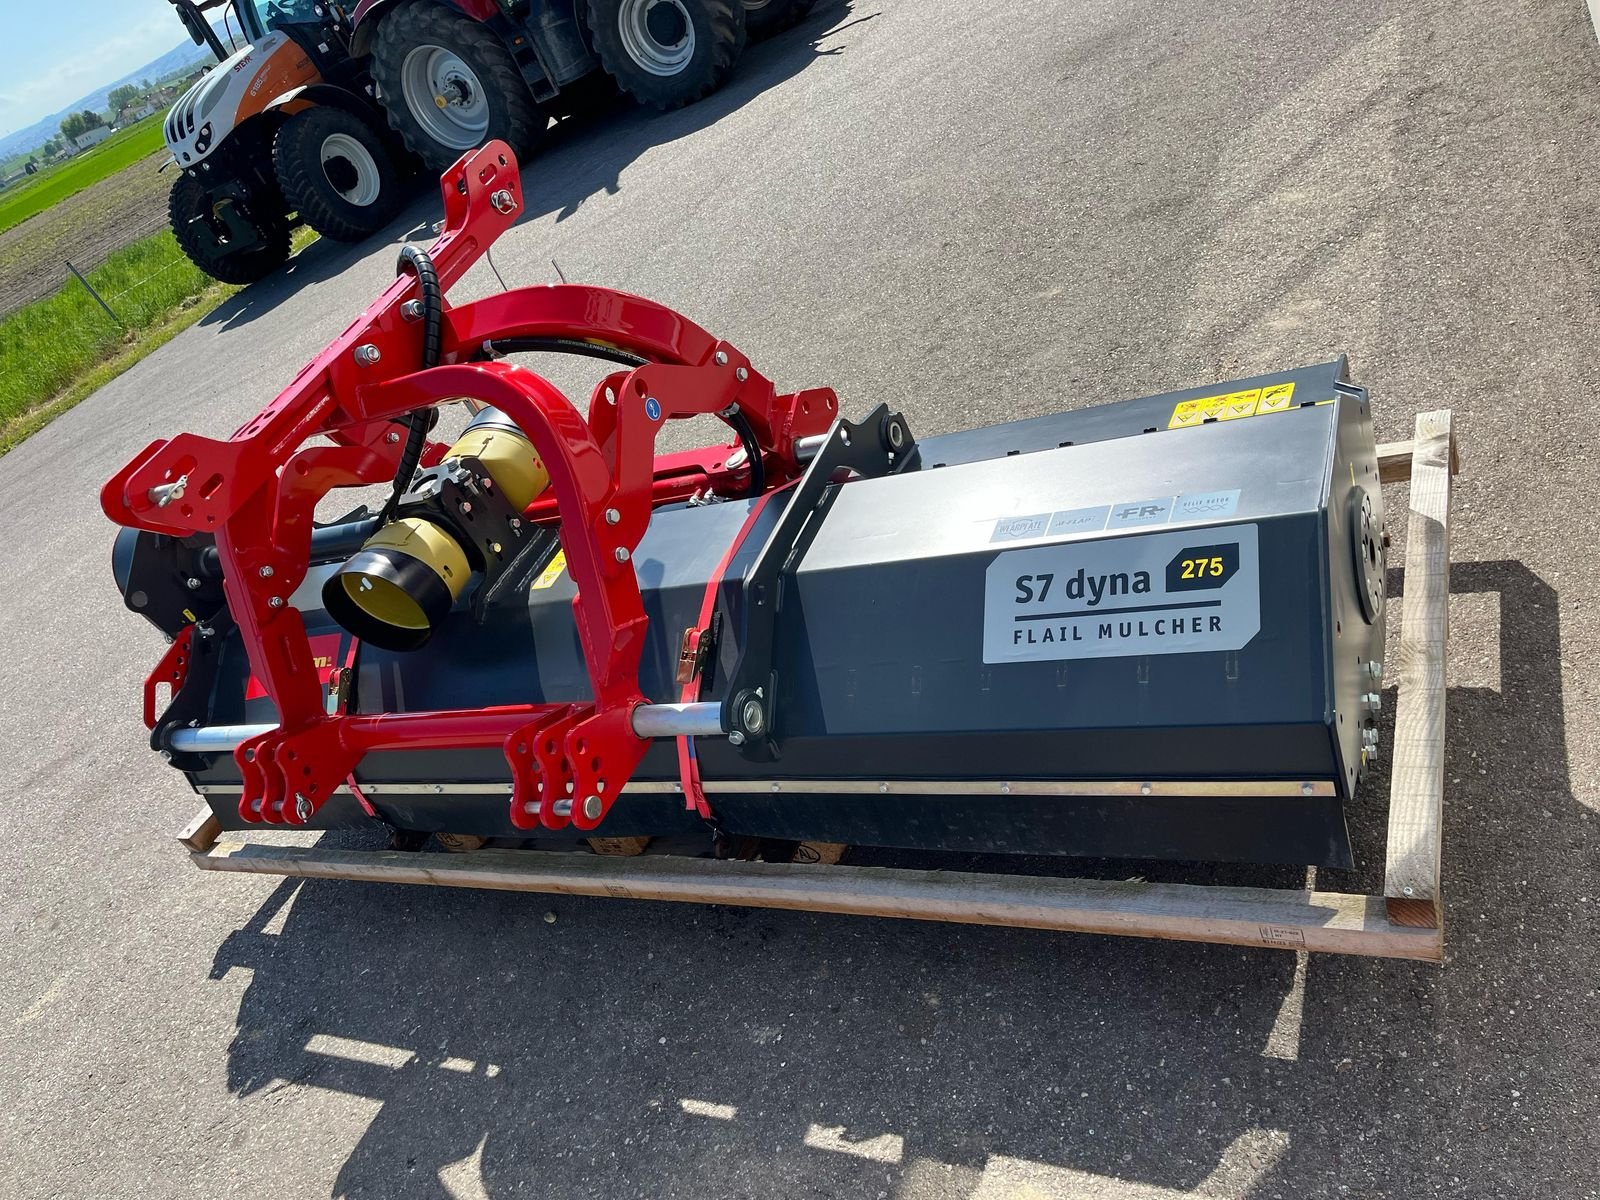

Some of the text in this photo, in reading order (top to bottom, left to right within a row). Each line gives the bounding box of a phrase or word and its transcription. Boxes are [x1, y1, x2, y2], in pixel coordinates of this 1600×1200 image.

[234, 55, 252, 72] STEYR
[999, 520, 1041, 533] WEARPLATE
[1181, 557, 1224, 579] 275
[1015, 568, 1151, 606] S7 dyna
[1013, 615, 1222, 644] FLAIL MULCHER
